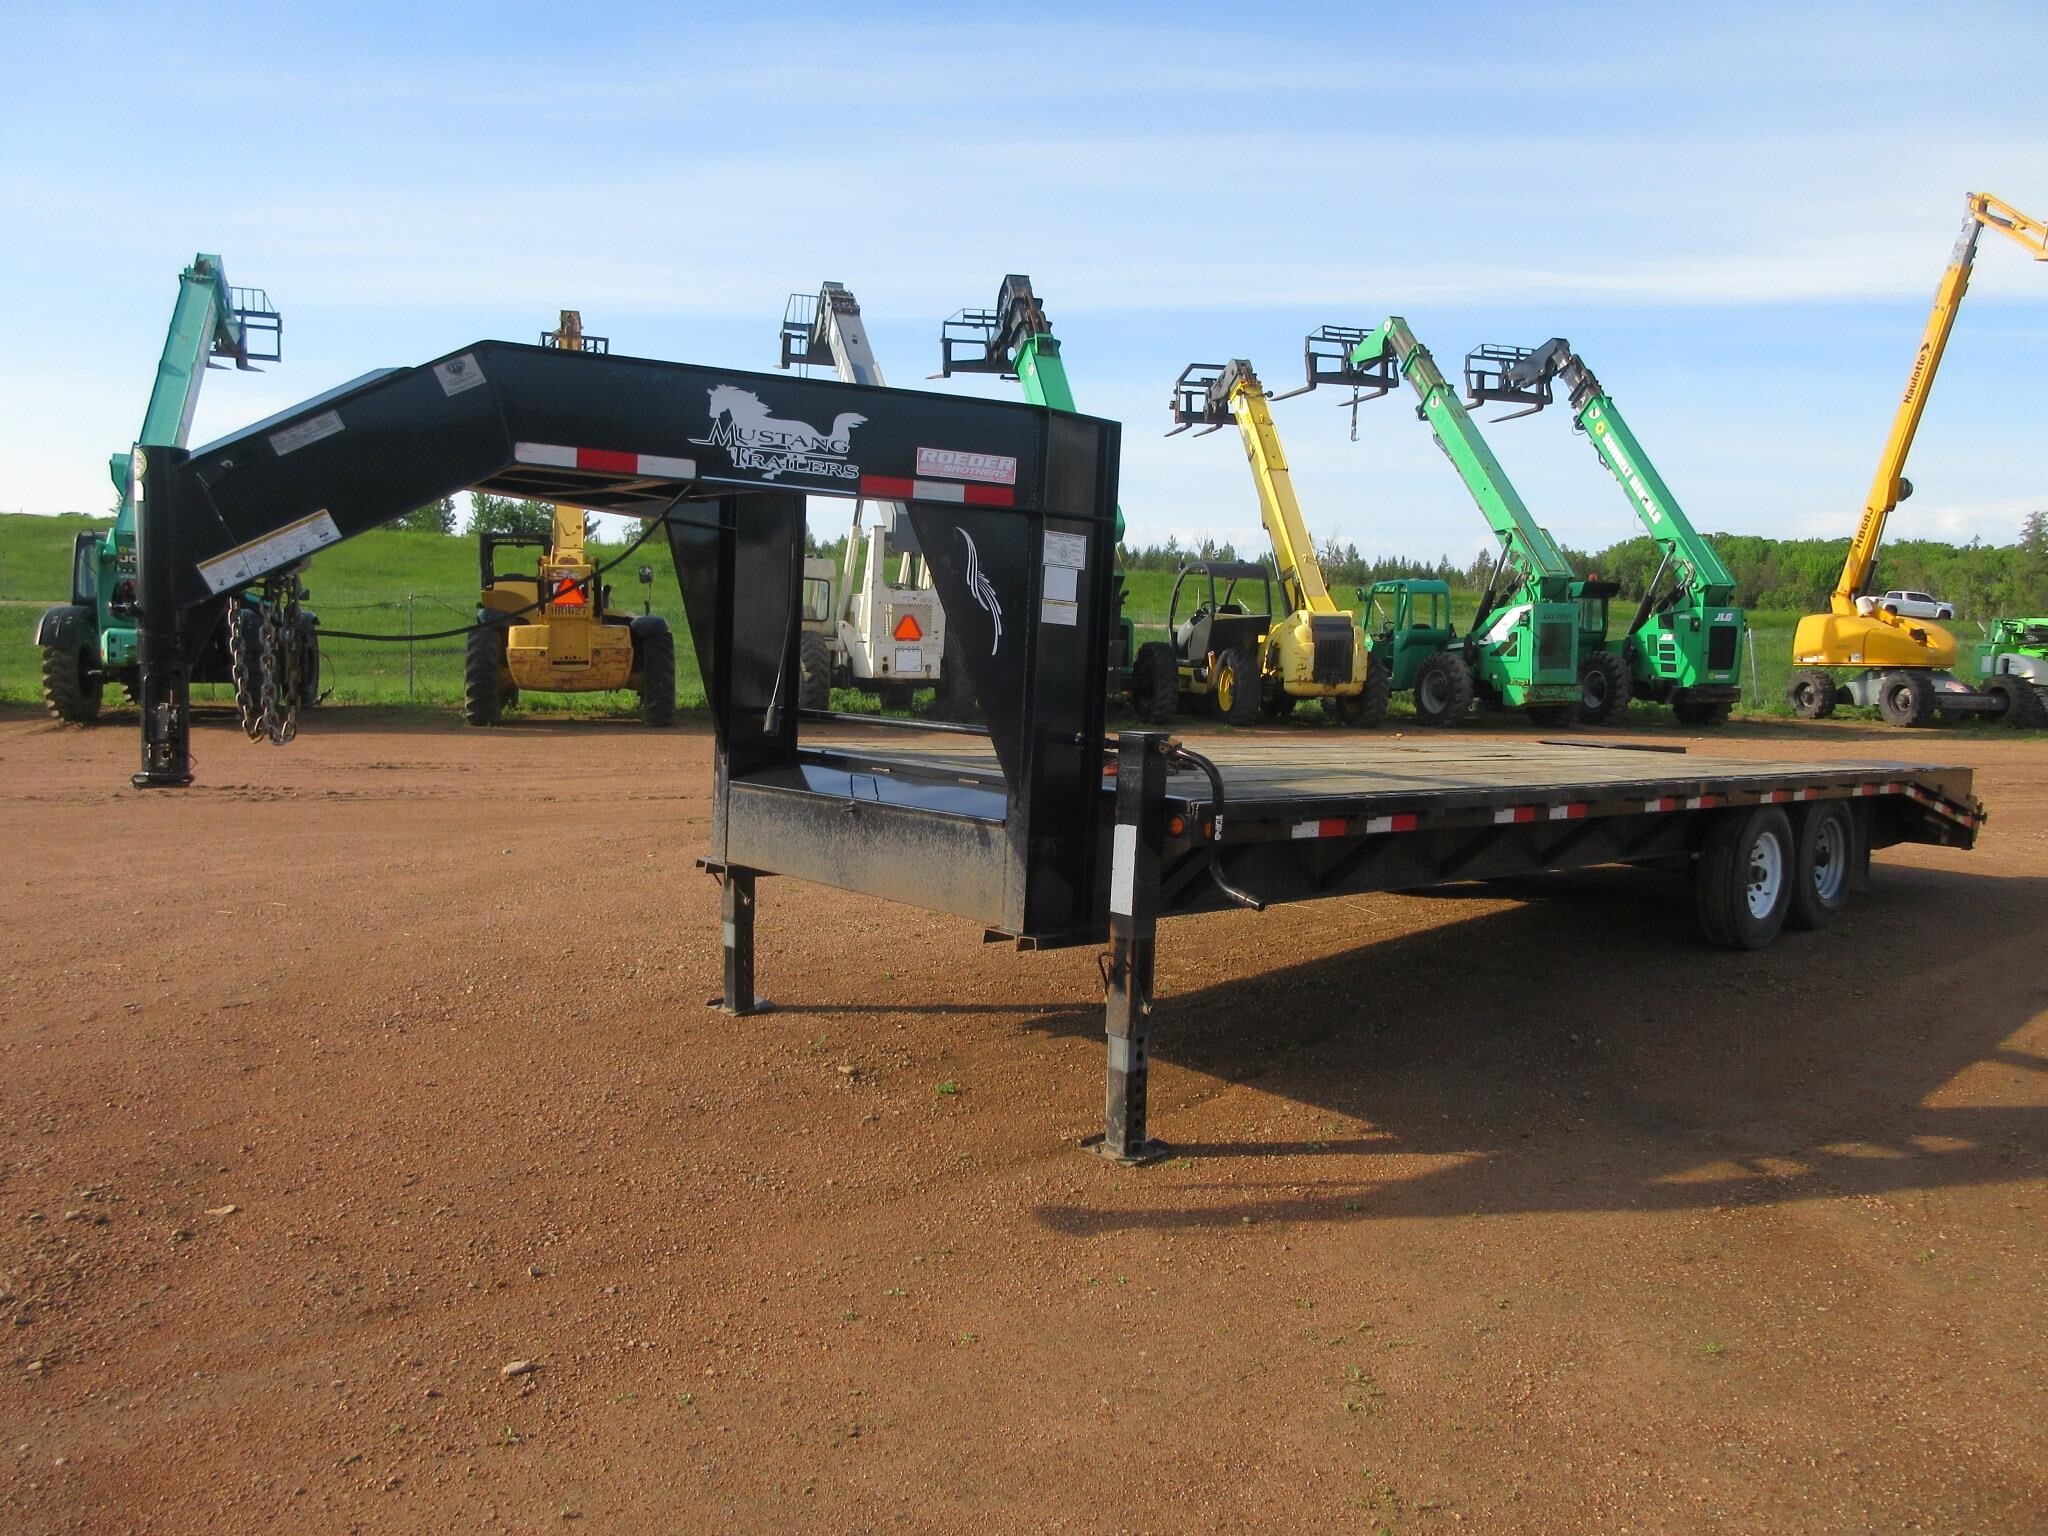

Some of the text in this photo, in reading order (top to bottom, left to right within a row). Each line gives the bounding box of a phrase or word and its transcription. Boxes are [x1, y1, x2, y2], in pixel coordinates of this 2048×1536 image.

[1903, 353, 1927, 404] Haulotte
[706, 418, 850, 454] MUSTANG
[921, 449, 1015, 471] ROEDER
[943, 464, 1010, 478] BROTHERS
[1854, 506, 1874, 549] HB68J
[1714, 612, 1733, 622] JLG
